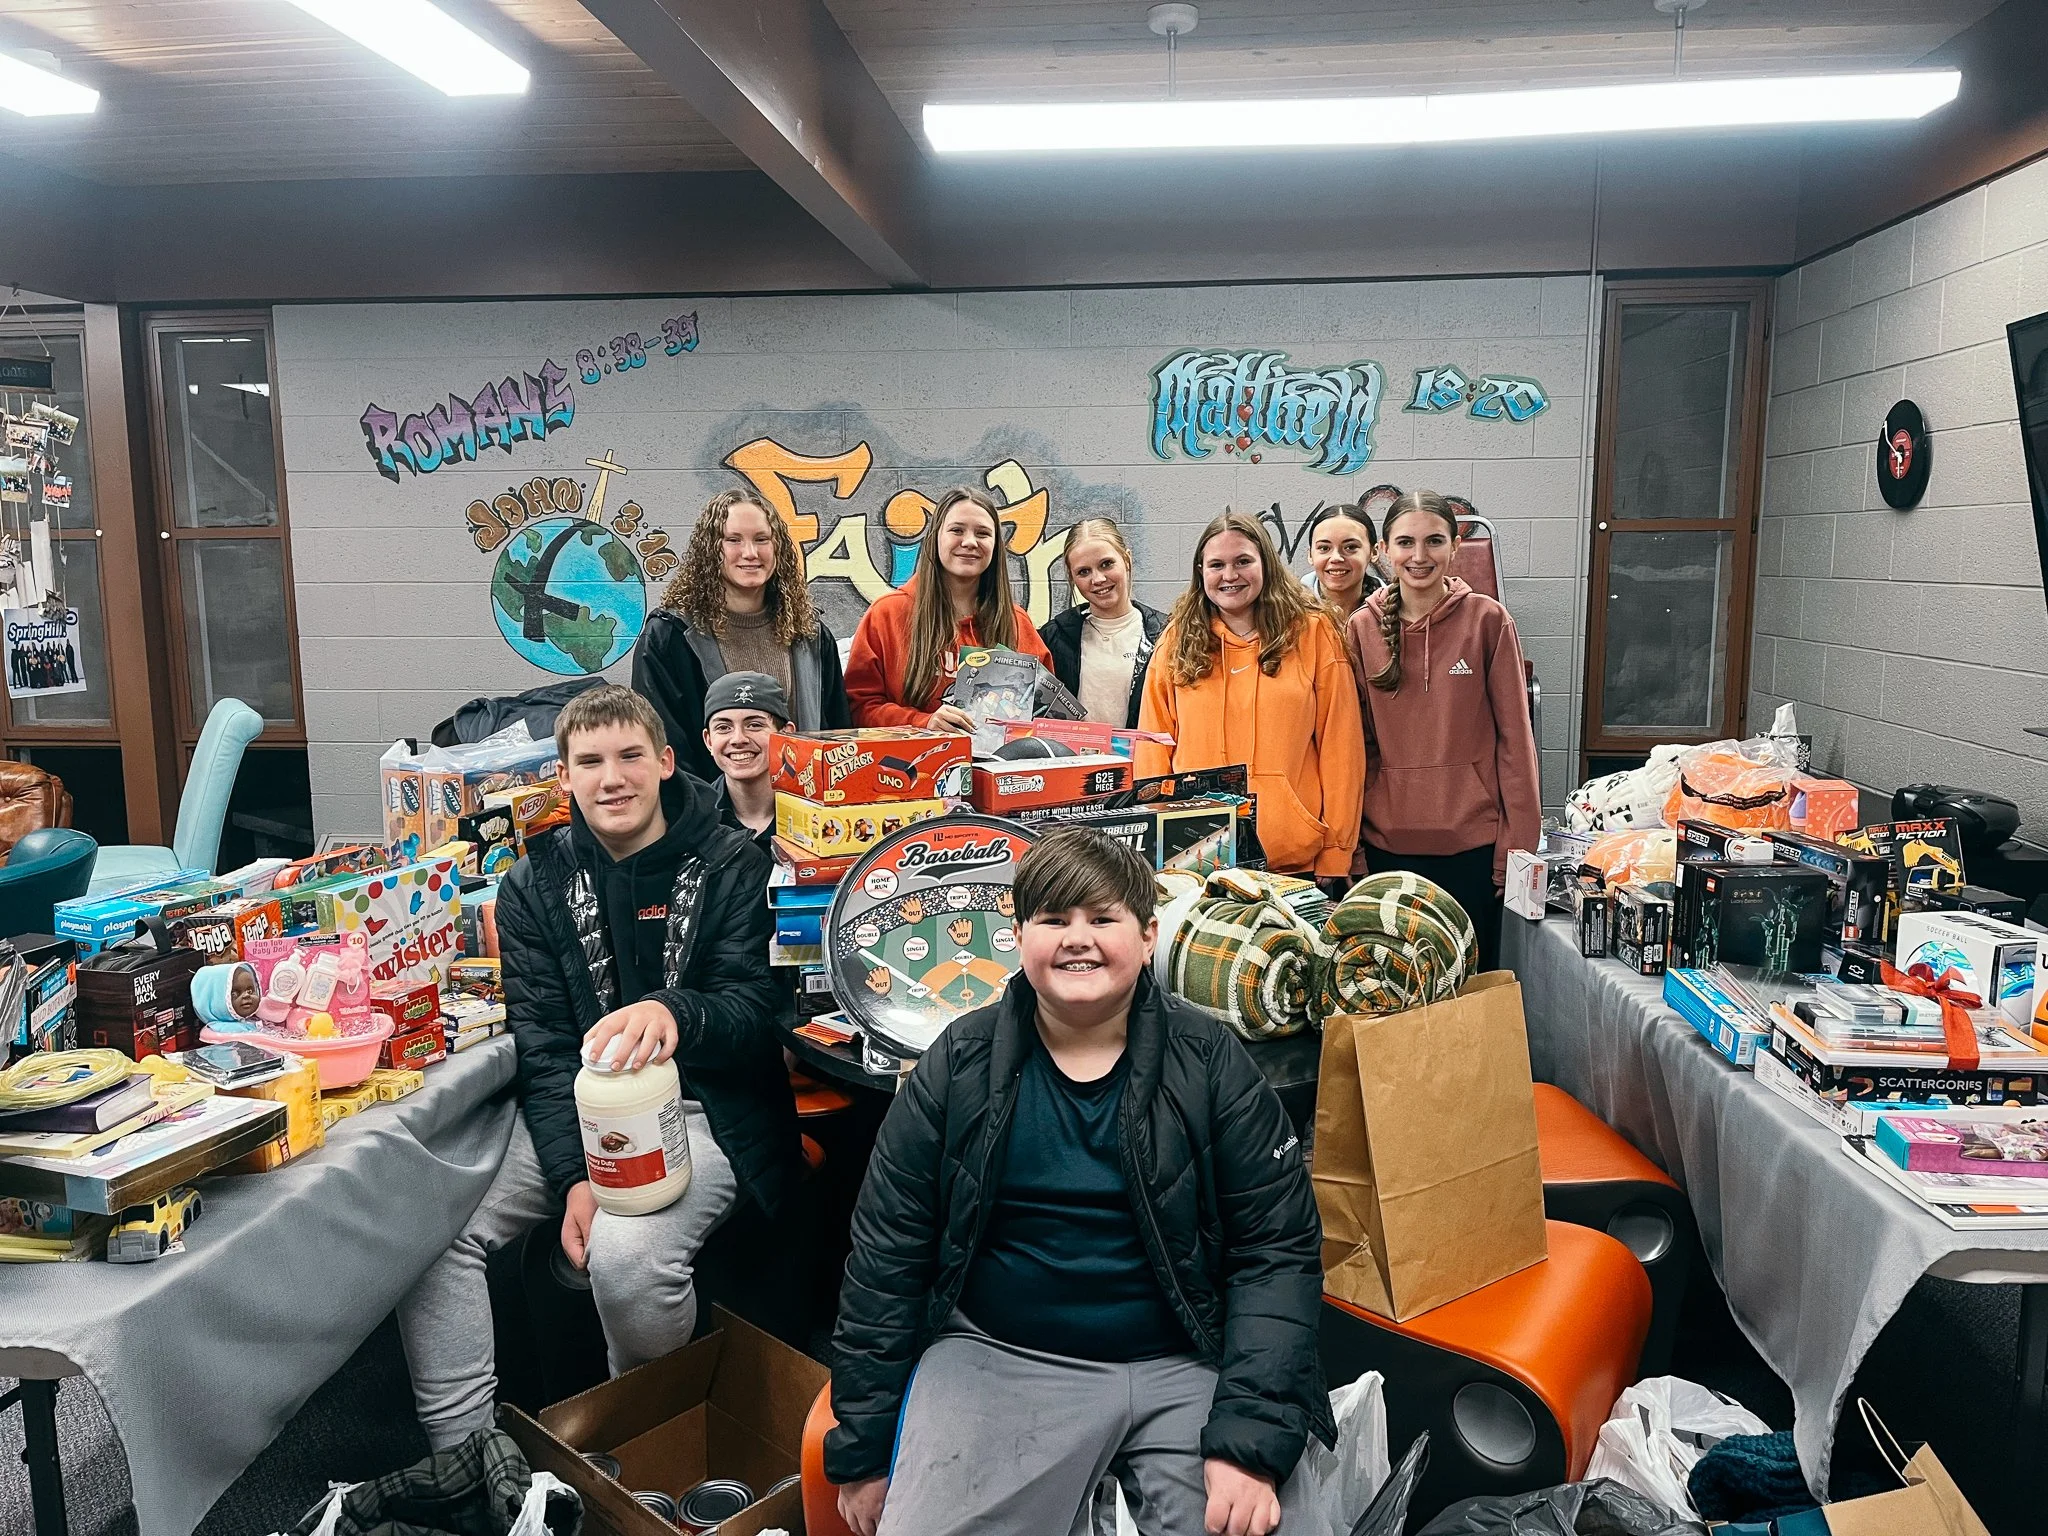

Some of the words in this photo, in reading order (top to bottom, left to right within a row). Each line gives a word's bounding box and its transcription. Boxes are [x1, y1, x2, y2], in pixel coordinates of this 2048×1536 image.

[361, 358, 576, 482] ROMANS
[575, 311, 699, 385] 8:38-39
[1405, 366, 1549, 421] 18:20
[466, 477, 585, 553] JOHN
[994, 656, 1037, 669] MINECRAFT
[824, 742, 858, 764] UNO
[829, 752, 873, 789] ATTACK
[1095, 772, 1108, 784] 62
[878, 773, 904, 789] UNO
[1095, 783, 1114, 792] PIECE
[402, 782, 419, 809] CENTER
[443, 783, 461, 811] CENTER
[517, 793, 548, 819] NERF
[1868, 825, 1889, 833] MAXX
[1895, 821, 1946, 833] MAXX
[1895, 830, 1947, 840] ACTION
[1686, 829, 1710, 844] SPEED
[898, 837, 1012, 869] Baseball
[1773, 842, 1802, 858] SPEED
[1847, 890, 1858, 923] SPEED
[60, 919, 92, 933] playmobil
[241, 911, 269, 941] Jenga
[1926, 925, 1950, 937] SOCCER
[1952, 934, 1968, 944] BALL
[188, 923, 233, 954] Jenga
[253, 940, 266, 948] Fun
[252, 946, 271, 955] Baby
[272, 944, 288, 953] Doll
[370, 922, 454, 981] wister
[133, 969, 161, 988] EVERY
[134, 982, 154, 997] MAN
[135, 989, 157, 1006] JACK
[404, 994, 430, 1010] APPLES
[409, 1001, 433, 1018] APPLES
[404, 1033, 434, 1050] APPLES
[409, 1040, 437, 1057] APPLES
[1878, 1076, 1983, 1091] SCATTERGORIES
[600, 1159, 616, 1168] Duty
